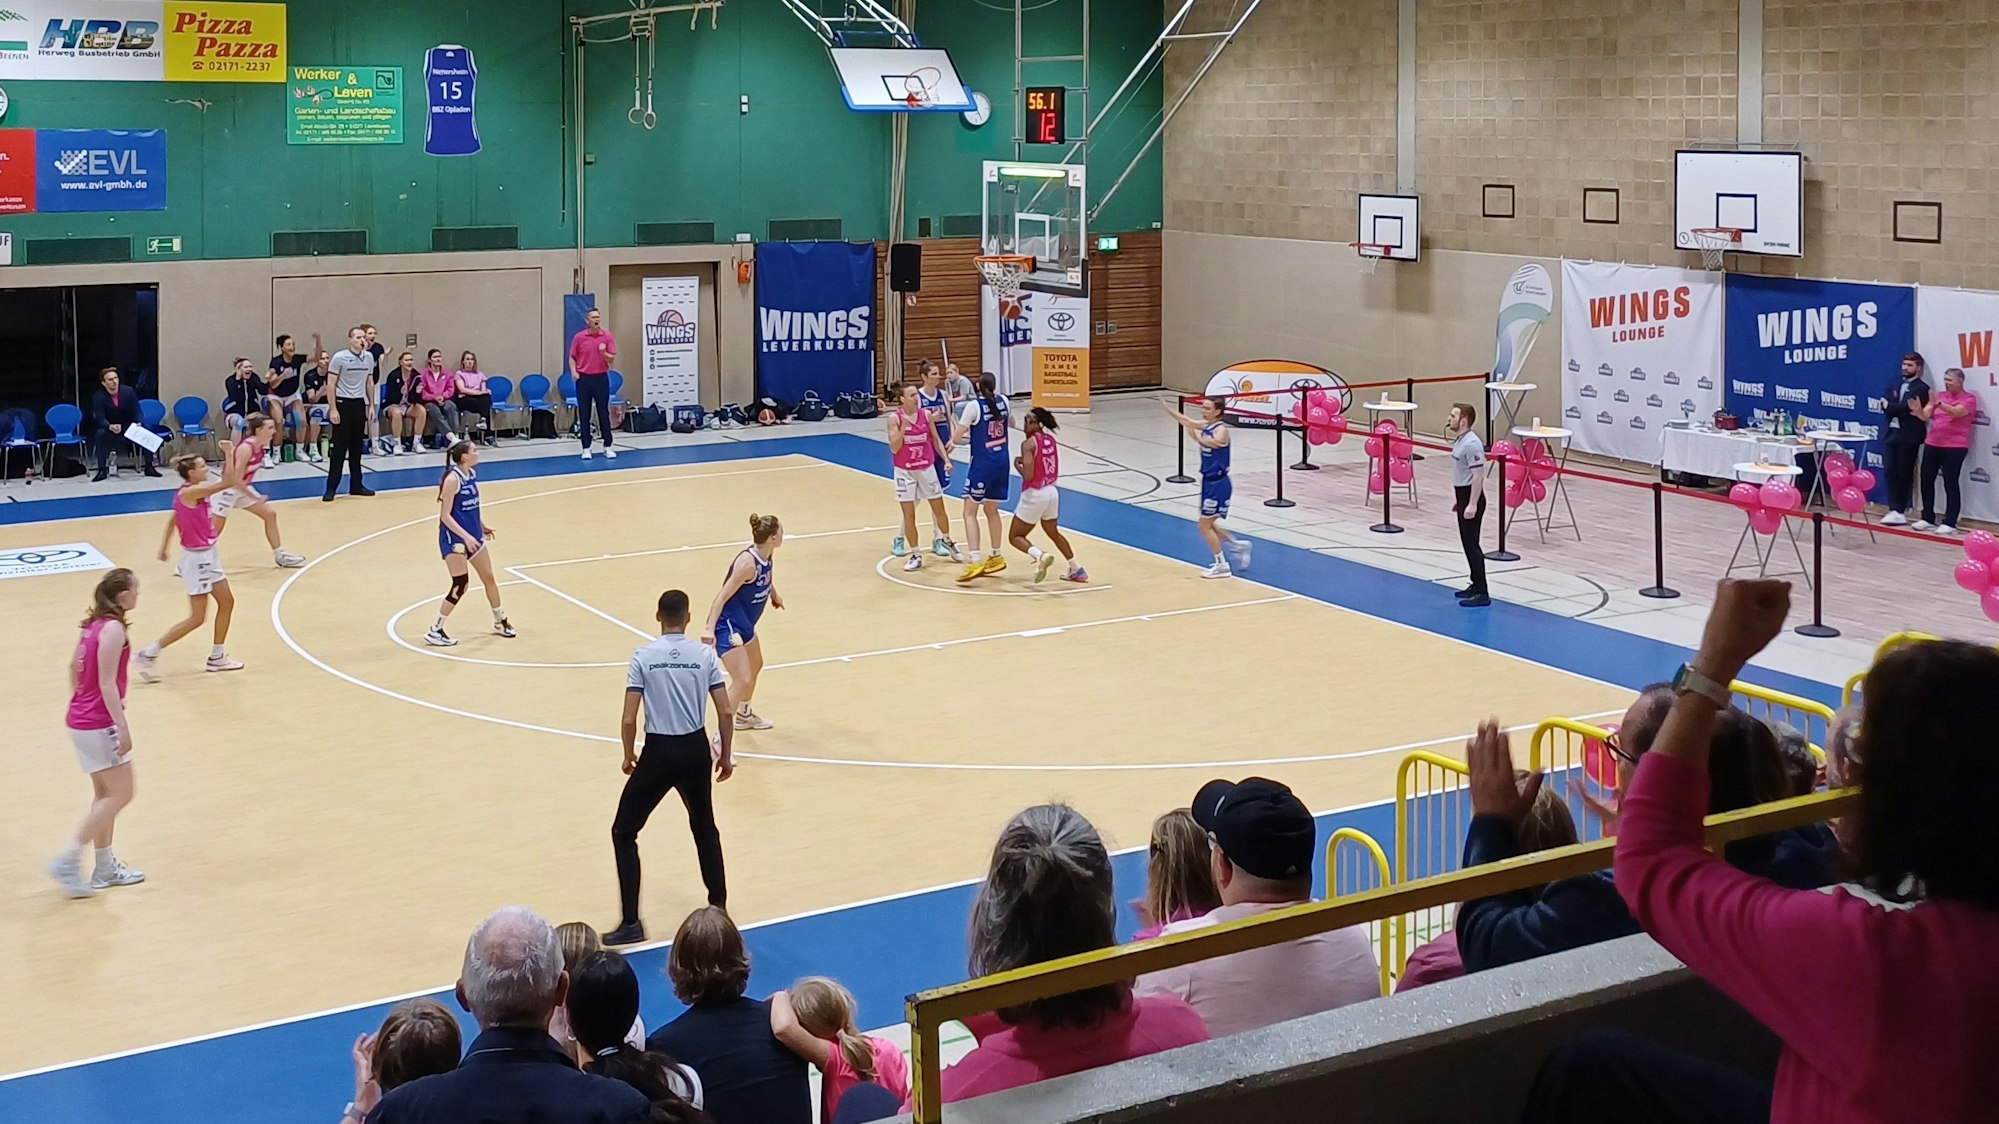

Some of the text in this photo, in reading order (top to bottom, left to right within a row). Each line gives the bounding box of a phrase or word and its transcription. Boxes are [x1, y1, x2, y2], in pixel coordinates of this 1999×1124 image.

[172, 12, 253, 35] Pizza
[39, 18, 160, 49] HBB
[133, 50, 161, 58] GmbH
[193, 36, 278, 58] Pazza
[294, 68, 342, 80] Werker
[347, 73, 358, 85] &
[440, 82, 463, 100] 15
[445, 106, 471, 114] Opladen
[1029, 92, 1055, 110] 56.1
[1040, 112, 1055, 141] 12
[88, 149, 147, 176] EVL
[61, 180, 147, 191] www.evl-gmbh.de
[1589, 286, 1690, 328] WINGS
[647, 323, 694, 340] WINGS
[760, 305, 870, 341] WINGS
[1757, 301, 1878, 348] WINGS
[1612, 326, 1665, 343] LOUNGE
[762, 339, 868, 352] LEVERKUSEN
[1784, 345, 1847, 364] LOUNGE
[1043, 353, 1078, 362] TOYOTA
